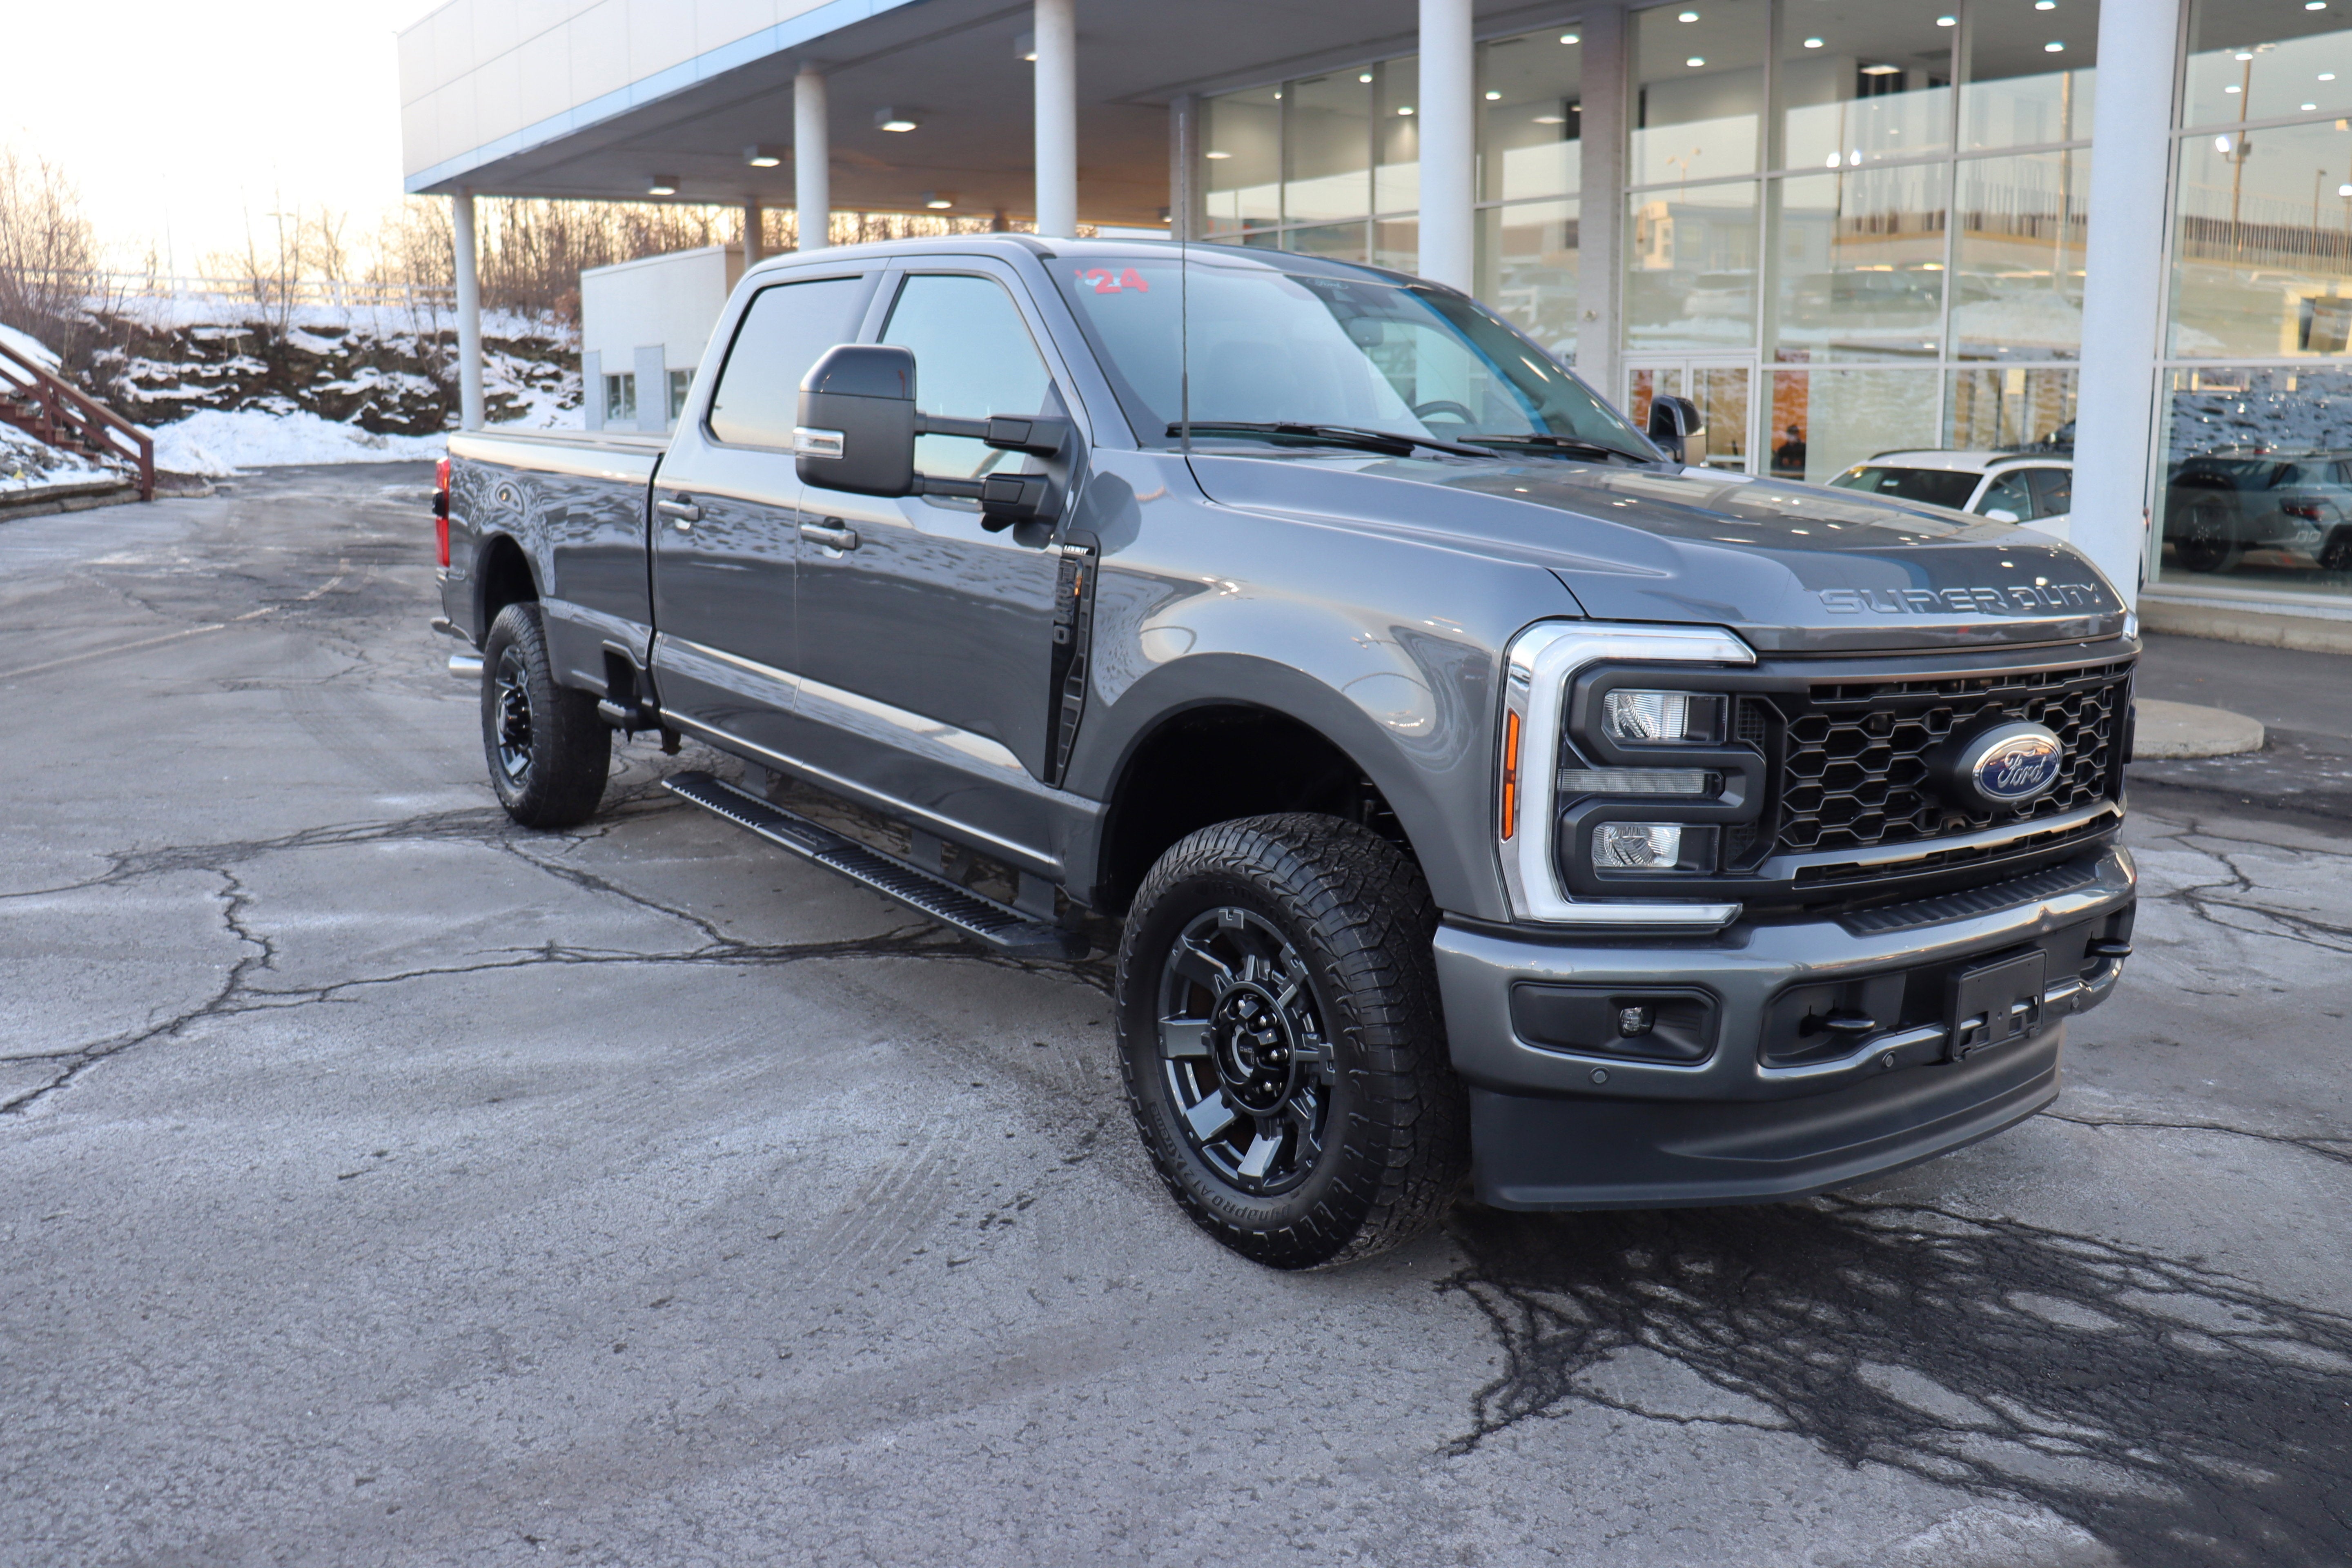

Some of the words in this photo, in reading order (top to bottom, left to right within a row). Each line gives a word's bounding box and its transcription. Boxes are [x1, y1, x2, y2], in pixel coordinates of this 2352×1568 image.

[1818, 587, 2009, 614] SUPER
[2008, 582, 2102, 611] DUTY
[1998, 748, 2046, 788] Ford
[1149, 1103, 1187, 1170] Xtreme
